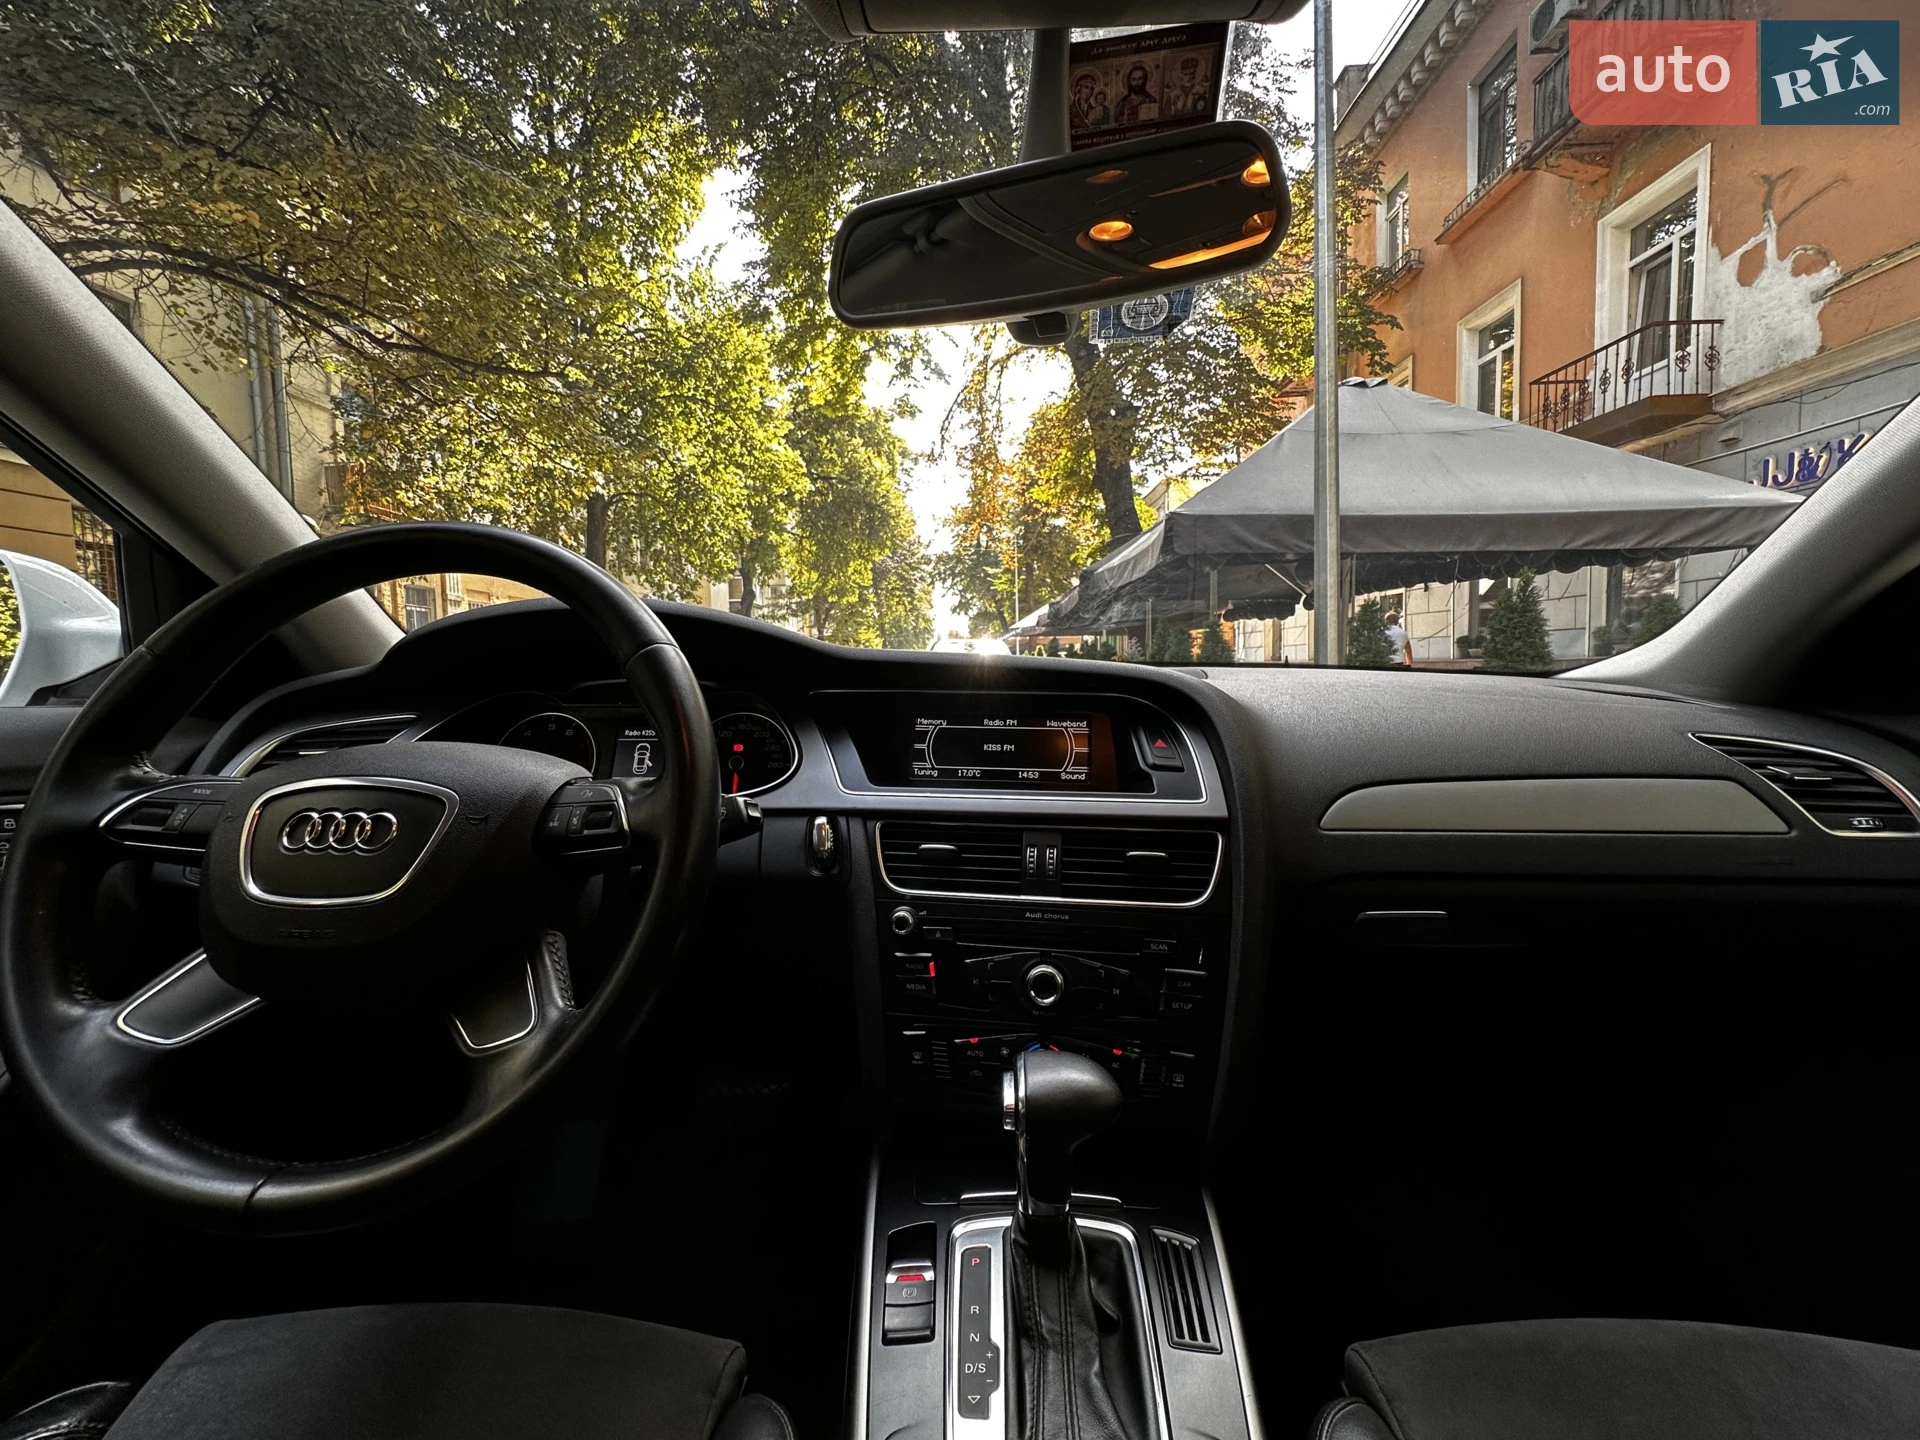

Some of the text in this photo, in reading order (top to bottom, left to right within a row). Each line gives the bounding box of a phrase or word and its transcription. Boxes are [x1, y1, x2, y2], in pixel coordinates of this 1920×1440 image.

[917, 718, 947, 726] Memory
[1046, 720, 1087, 728] Waveband
[547, 723, 557, 731] 5
[565, 728, 574, 736] 6
[624, 729, 641, 737] Radio
[913, 768, 938, 777] Tuning
[1060, 772, 1086, 780] Sound
[1025, 911, 1070, 920] Audi chorus
[1150, 943, 1168, 951] SCAN
[1171, 1002, 1193, 1010] SETUP
[971, 1258, 980, 1266] P
[970, 1305, 980, 1314] R
[969, 1332, 980, 1342] N
[965, 1362, 986, 1374] D/S
